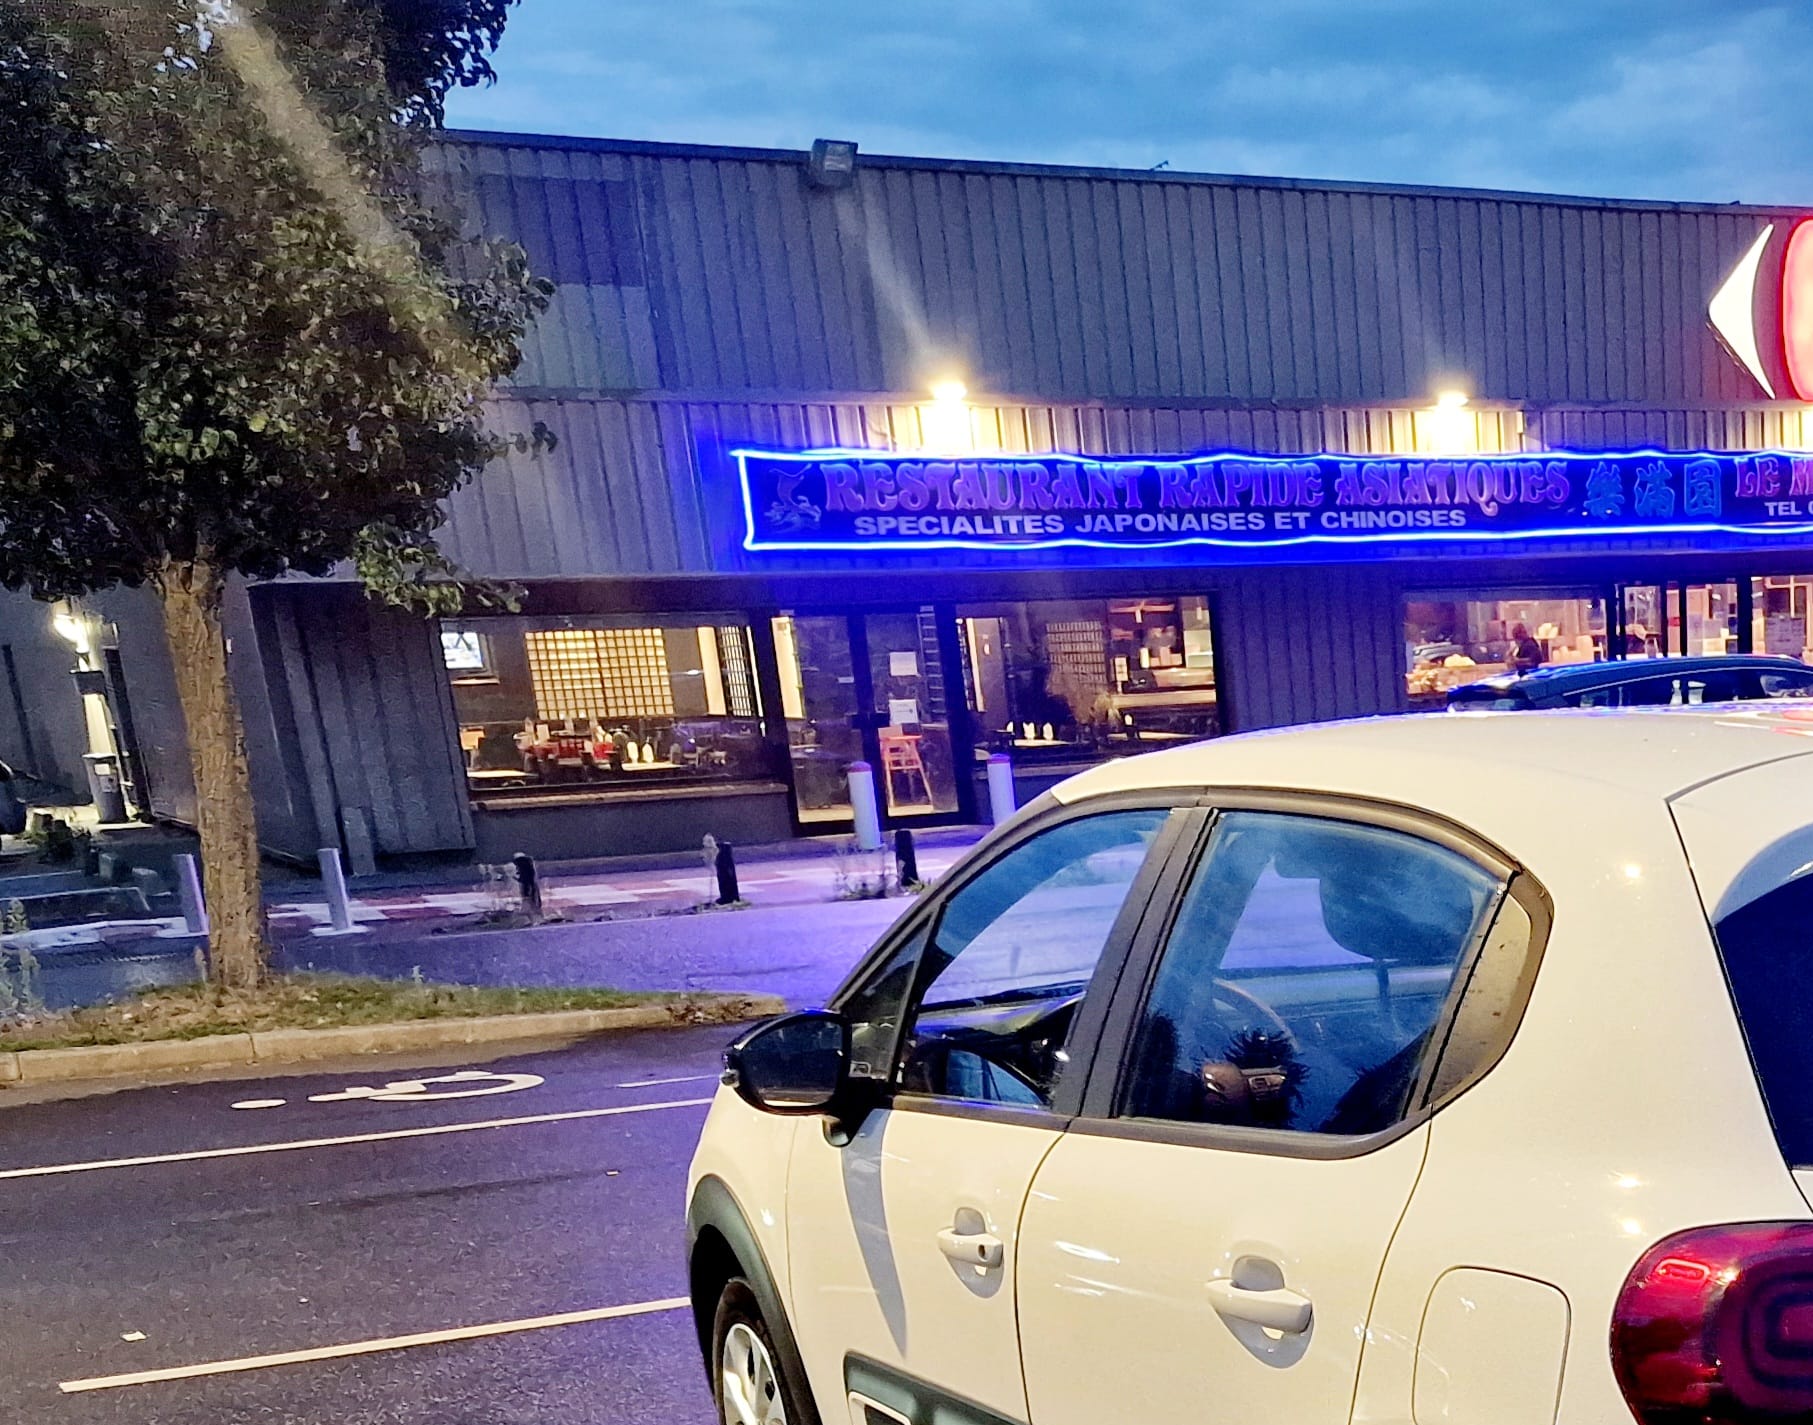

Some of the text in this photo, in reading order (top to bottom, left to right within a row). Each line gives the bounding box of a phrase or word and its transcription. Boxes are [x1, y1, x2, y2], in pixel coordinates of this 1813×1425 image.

[819, 461, 1571, 517] RESTAURANT RAPIDE ASIATIQUES
[1733, 456, 1781, 498] LE
[854, 509, 1467, 535] SPECIALITES JAPONAISES ET CHINOISES
[1764, 501, 1802, 517] TEL
